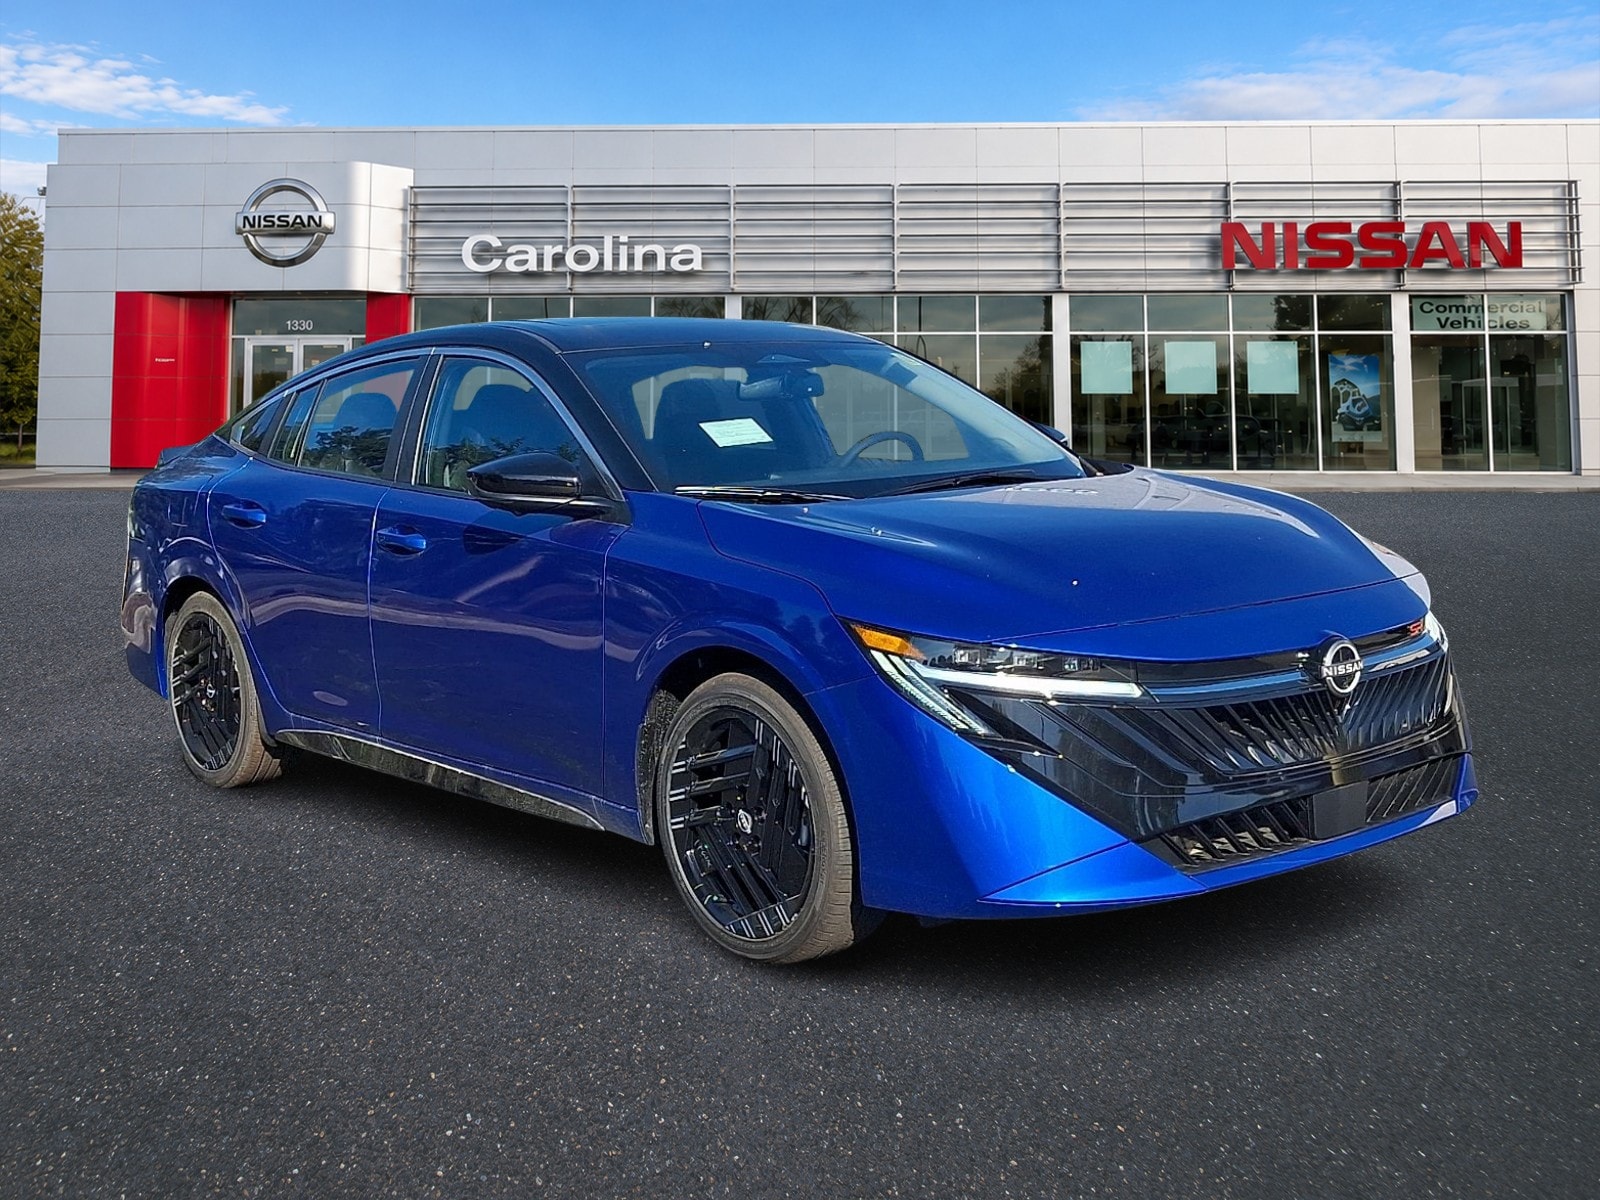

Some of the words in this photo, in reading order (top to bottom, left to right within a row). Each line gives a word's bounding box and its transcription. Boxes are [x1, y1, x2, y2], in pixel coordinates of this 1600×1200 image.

[242, 214, 322, 229] NISSAN
[1220, 221, 1523, 269] NISSAN
[461, 234, 703, 273] Carolina
[1419, 301, 1543, 314] Commercial
[285, 319, 314, 331] 1330
[1436, 315, 1530, 329] Vehicles
